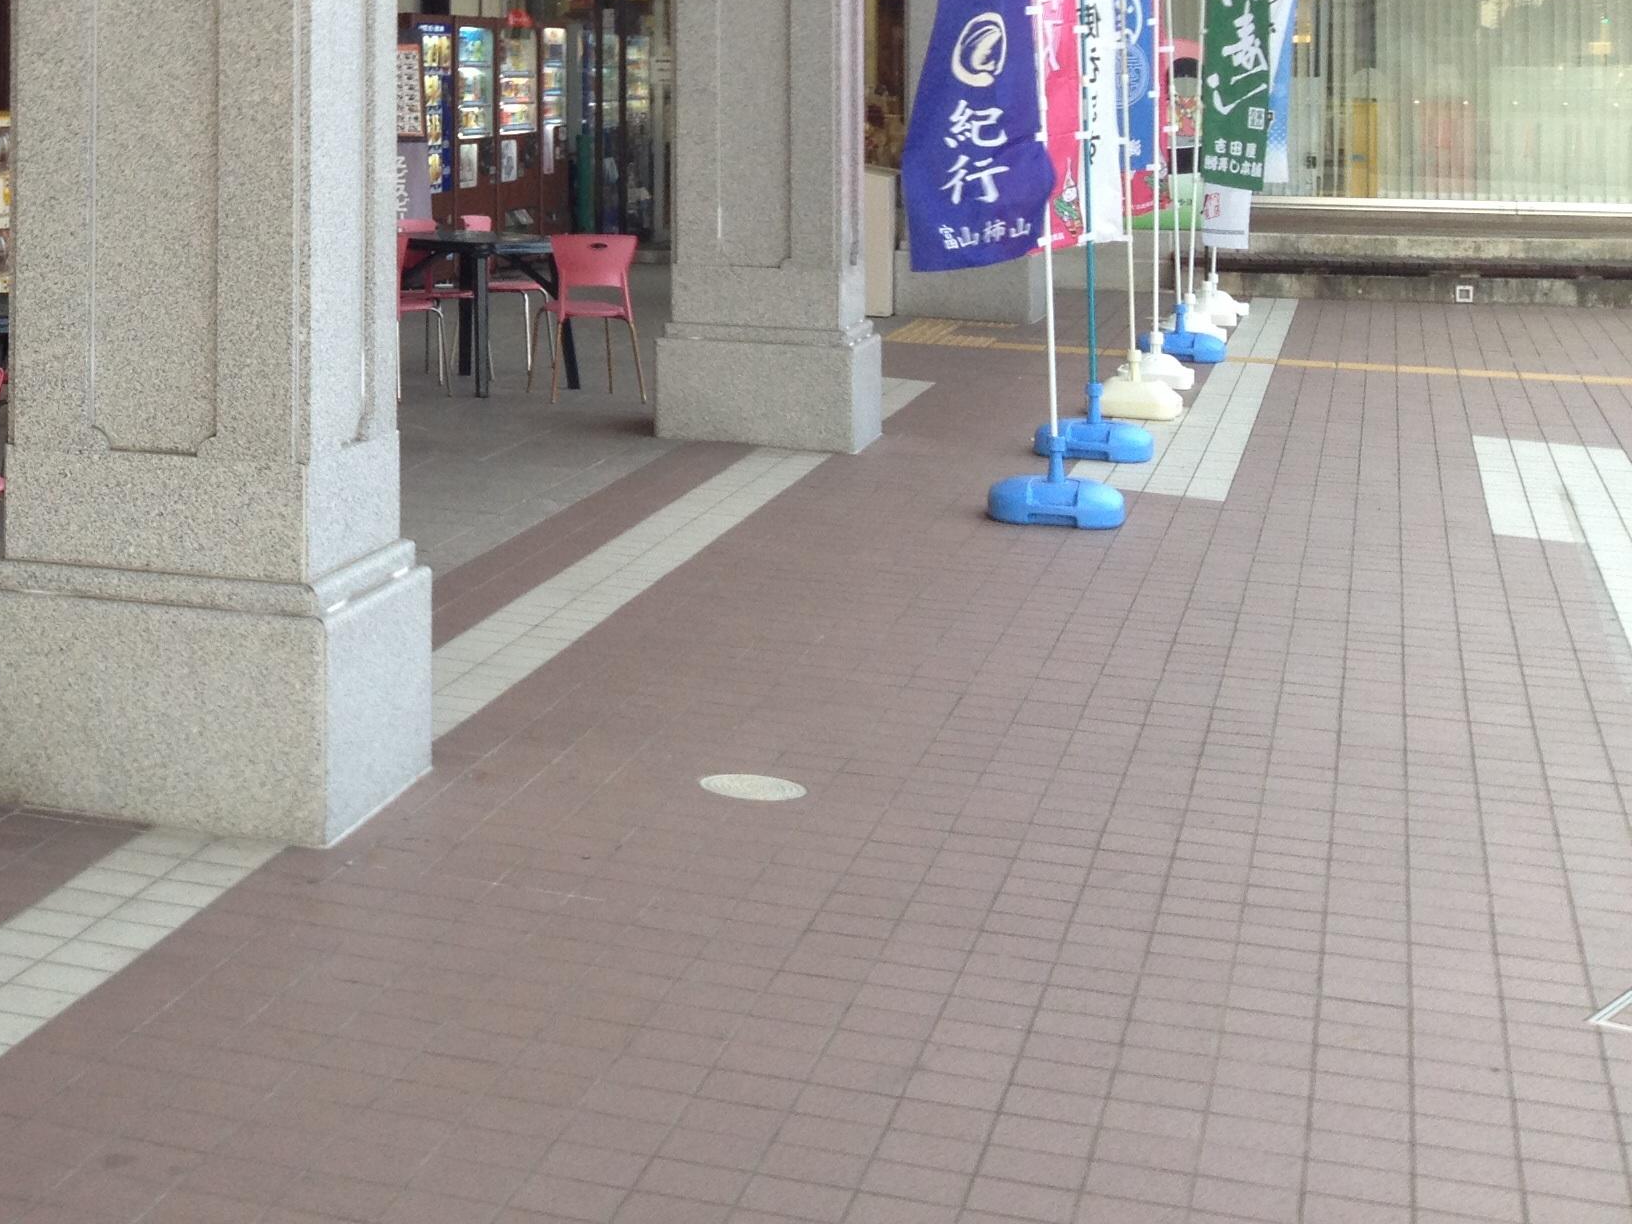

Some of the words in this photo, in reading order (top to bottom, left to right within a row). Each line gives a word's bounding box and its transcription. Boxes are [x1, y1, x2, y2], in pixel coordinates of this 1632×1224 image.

[939, 99, 1010, 205] 紀行
[939, 217, 1032, 250] 富山柿山
